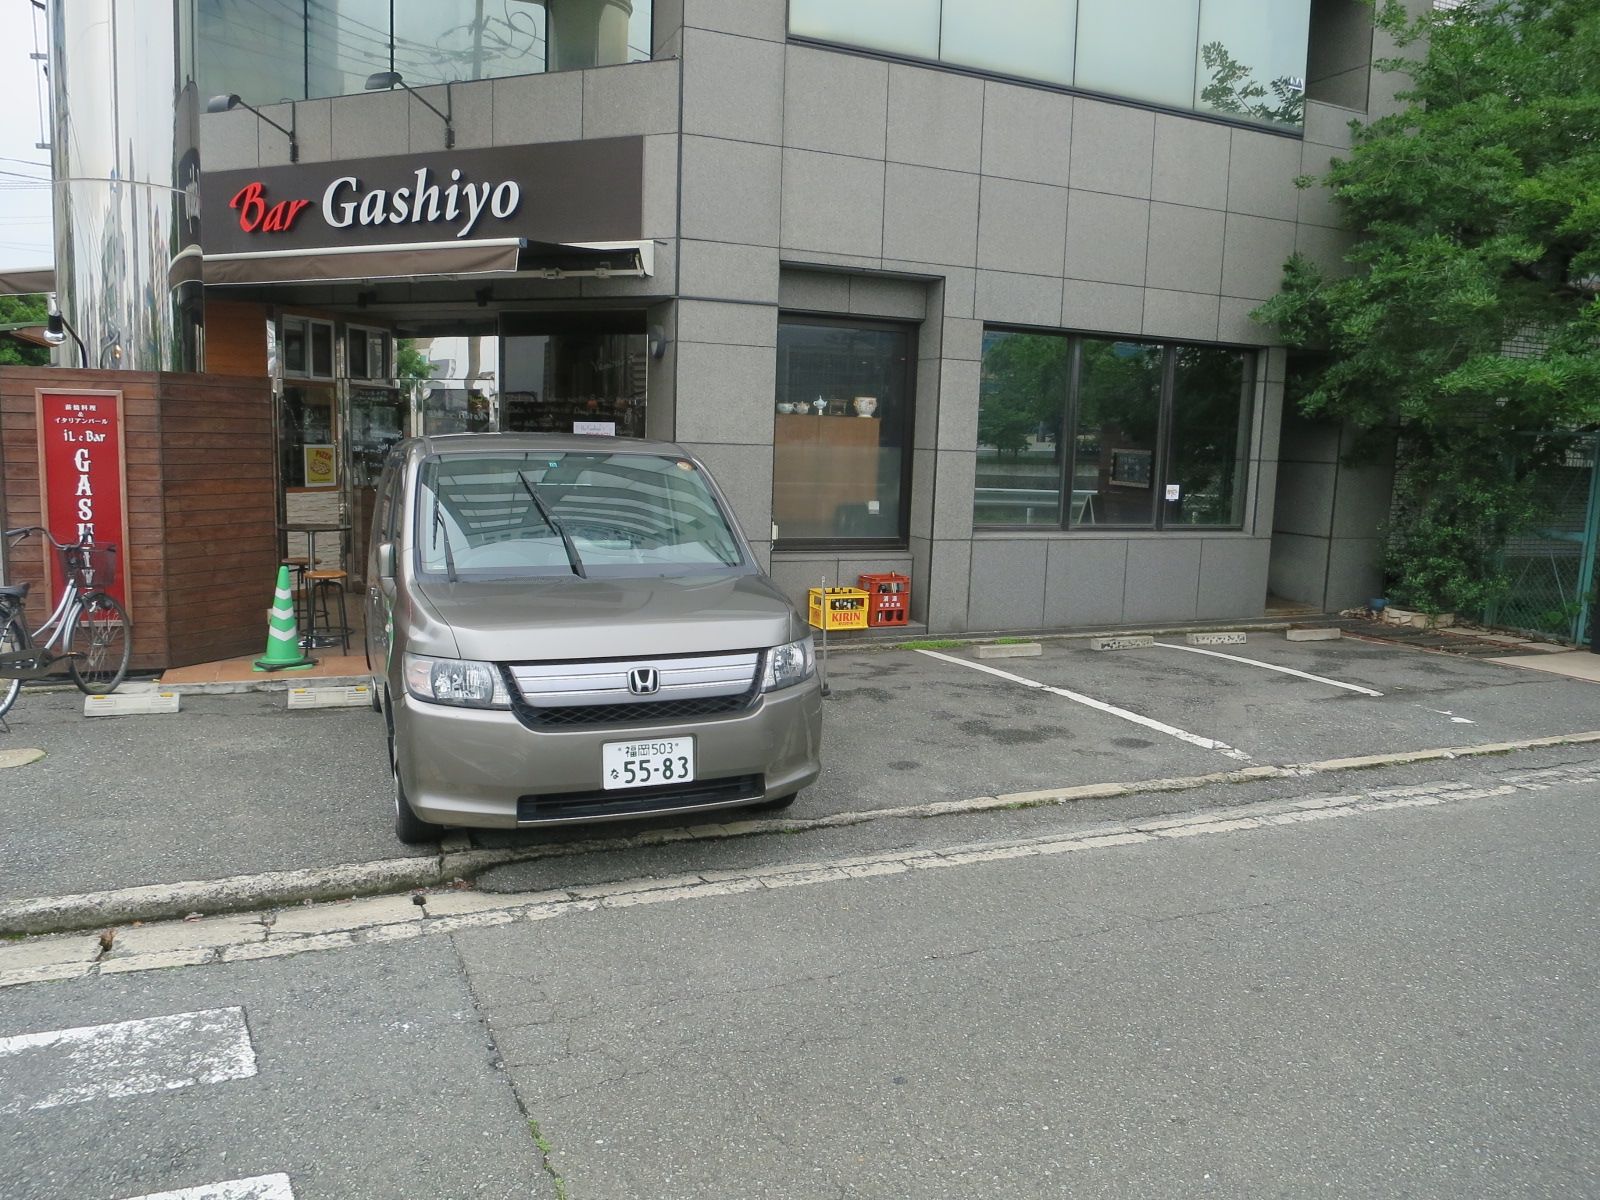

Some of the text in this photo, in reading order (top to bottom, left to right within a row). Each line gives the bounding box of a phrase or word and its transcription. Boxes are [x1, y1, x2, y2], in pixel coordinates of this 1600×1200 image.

[229, 167, 520, 238] Bar Gashiyo
[831, 612, 861, 622] KIRIN
[625, 742, 674, 757] 福岡 503
[623, 756, 689, 784] 55-83
